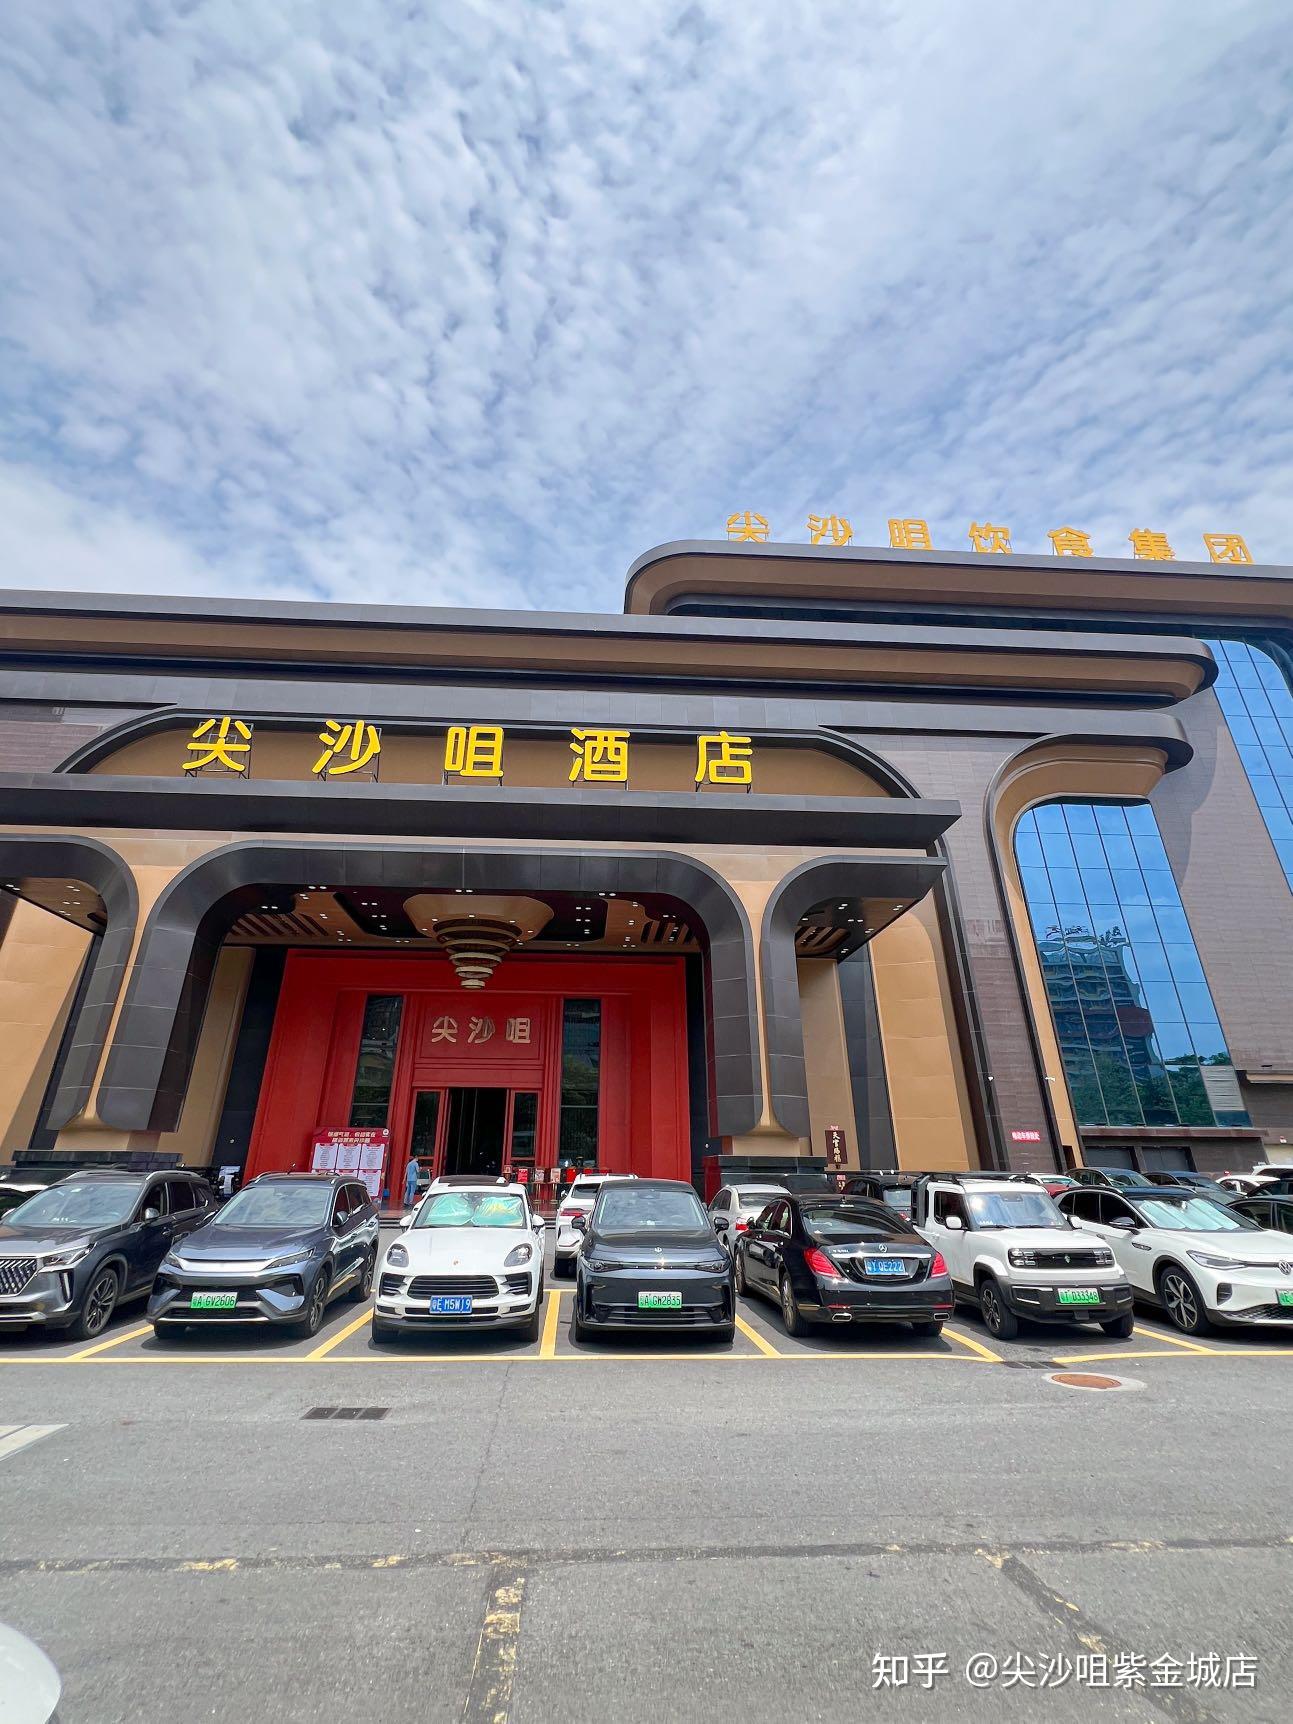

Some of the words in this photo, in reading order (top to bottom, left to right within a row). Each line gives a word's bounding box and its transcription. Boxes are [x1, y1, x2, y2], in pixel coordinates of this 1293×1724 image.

[727, 511, 1254, 565] 尖沙咀饮食集团
[182, 716, 753, 785] 尖沙咀酒店
[431, 1016, 531, 1044] 尖沙咀
